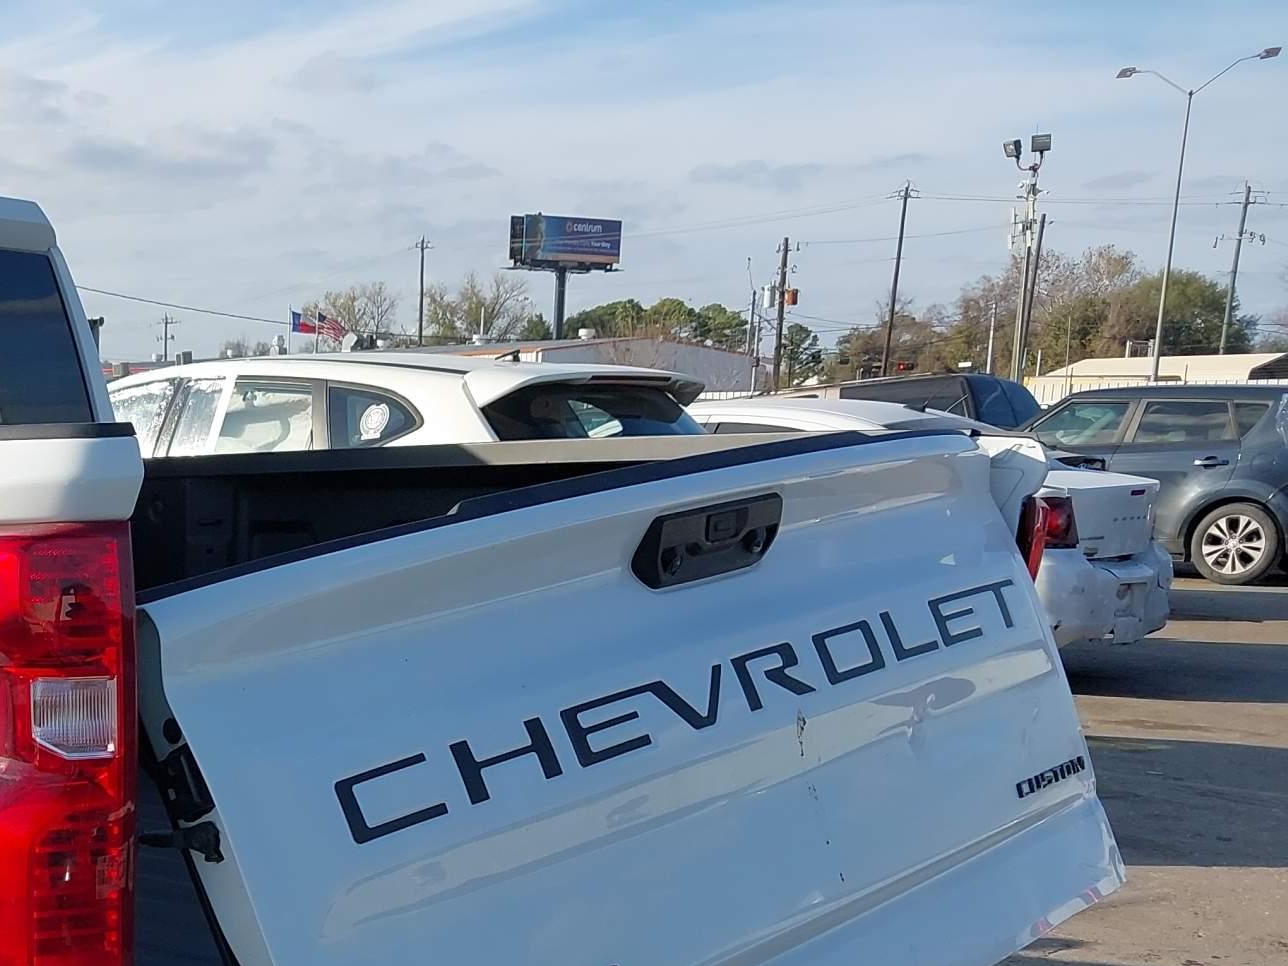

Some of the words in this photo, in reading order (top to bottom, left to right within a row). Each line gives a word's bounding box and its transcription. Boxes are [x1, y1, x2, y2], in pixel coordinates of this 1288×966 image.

[573, 222, 603, 232] centrum
[334, 579, 1014, 845] CHEVROLET
[1016, 755, 1086, 799] CUSTOM
